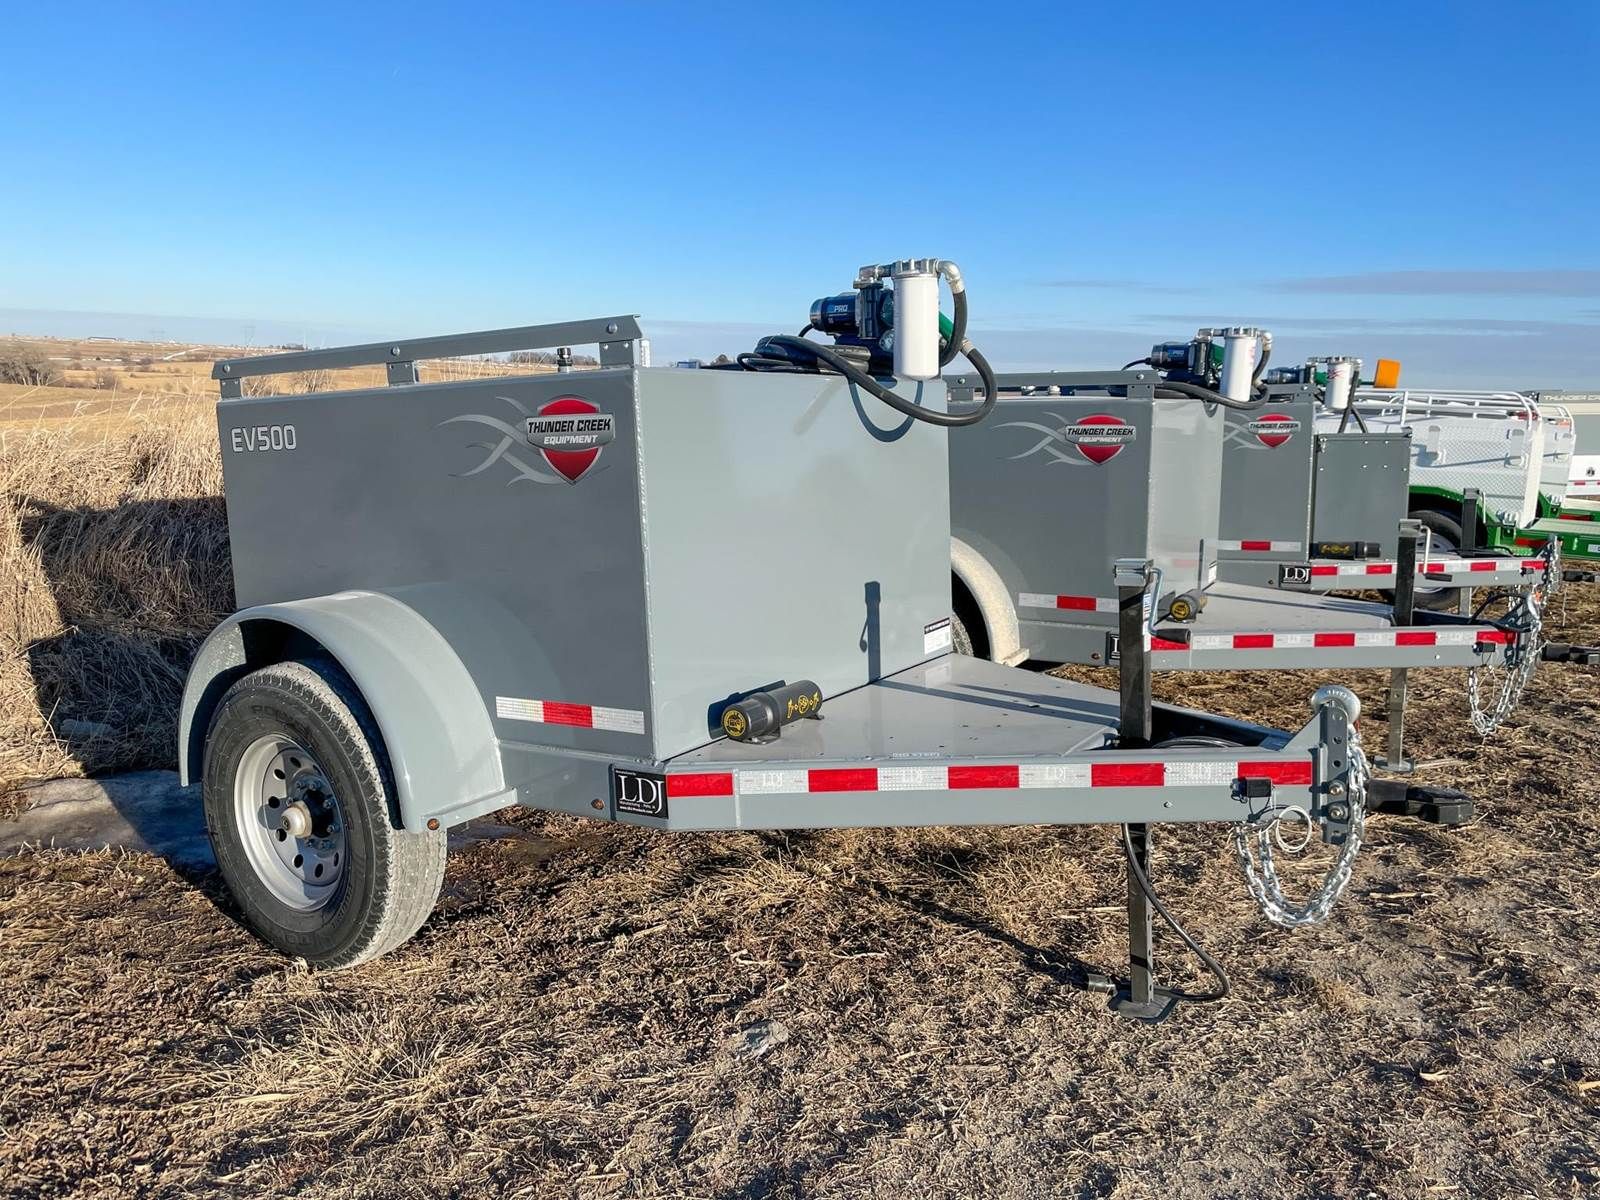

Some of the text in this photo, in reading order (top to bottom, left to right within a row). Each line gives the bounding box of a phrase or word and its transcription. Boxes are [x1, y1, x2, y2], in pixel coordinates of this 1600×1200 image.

[528, 418, 611, 434] THUNDER CREEK
[1067, 427, 1134, 436] THUNDER CREEK
[231, 424, 297, 452] EV500
[543, 434, 598, 446] EQUIPMENT
[1284, 567, 1311, 583] LDJ
[618, 774, 665, 814] LDJ
